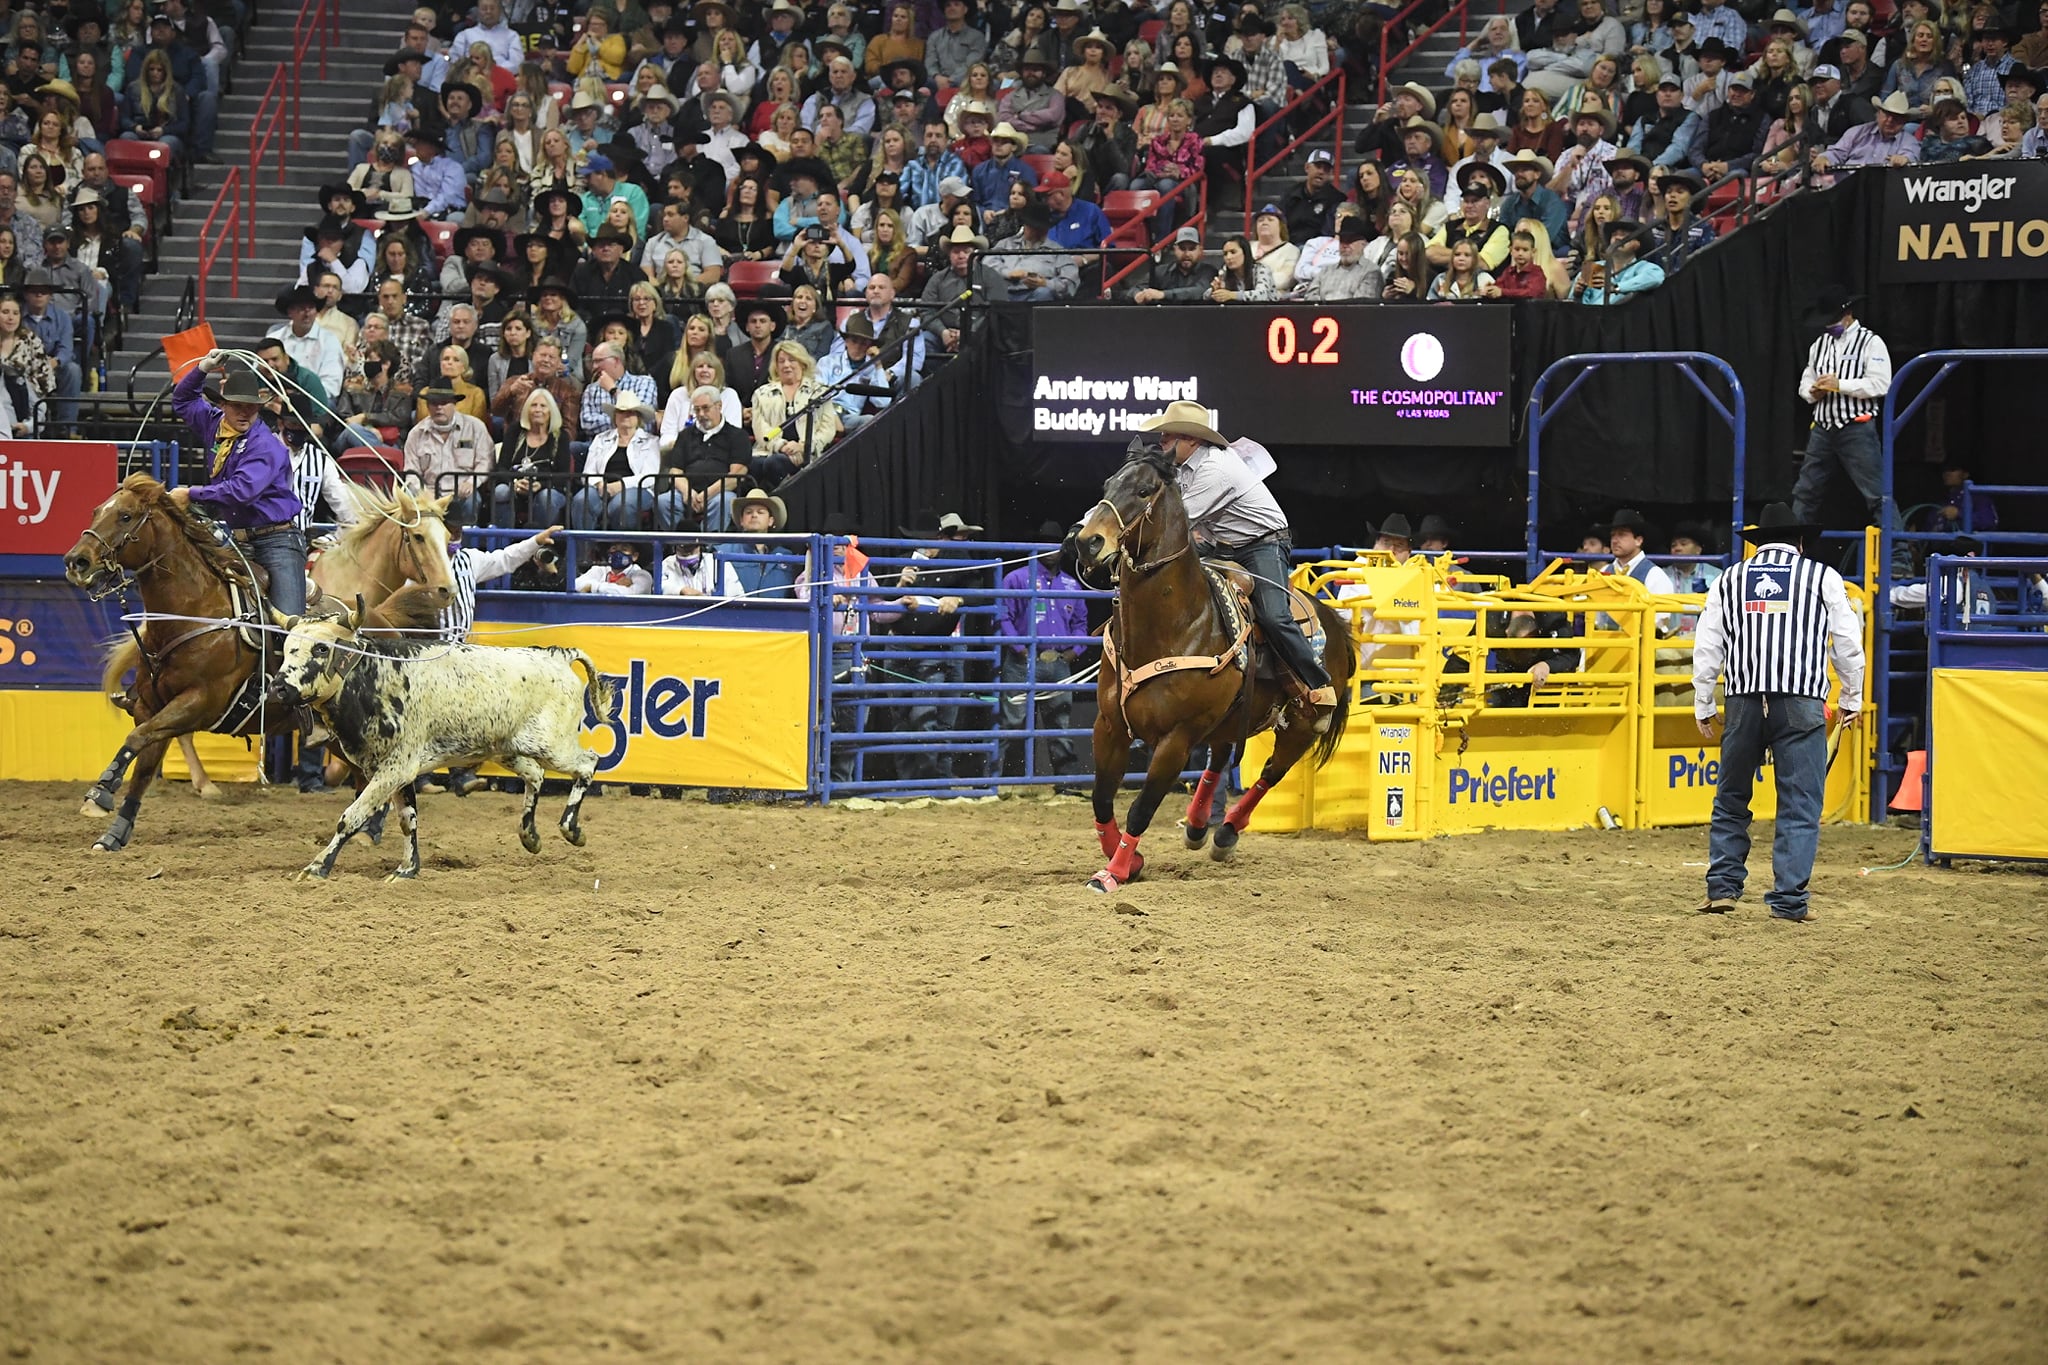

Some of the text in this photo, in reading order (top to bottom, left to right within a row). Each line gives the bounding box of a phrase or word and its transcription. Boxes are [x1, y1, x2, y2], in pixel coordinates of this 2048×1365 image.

[1903, 174, 2016, 213] Wrangler
[1898, 219, 2048, 261] NATIO
[1268, 317, 1339, 364] 0.2
[1034, 376, 1198, 400] Andrew Ward
[1351, 390, 1378, 405] THE
[1034, 408, 1105, 435] Buddy
[1406, 410, 1421, 418] LAS
[1423, 410, 1450, 418] VEGAS
[1393, 598, 1420, 608] Priefert
[1380, 728, 1411, 744] Wrangler
[1379, 751, 1411, 774] NFR
[1449, 761, 1556, 804] Priefert
